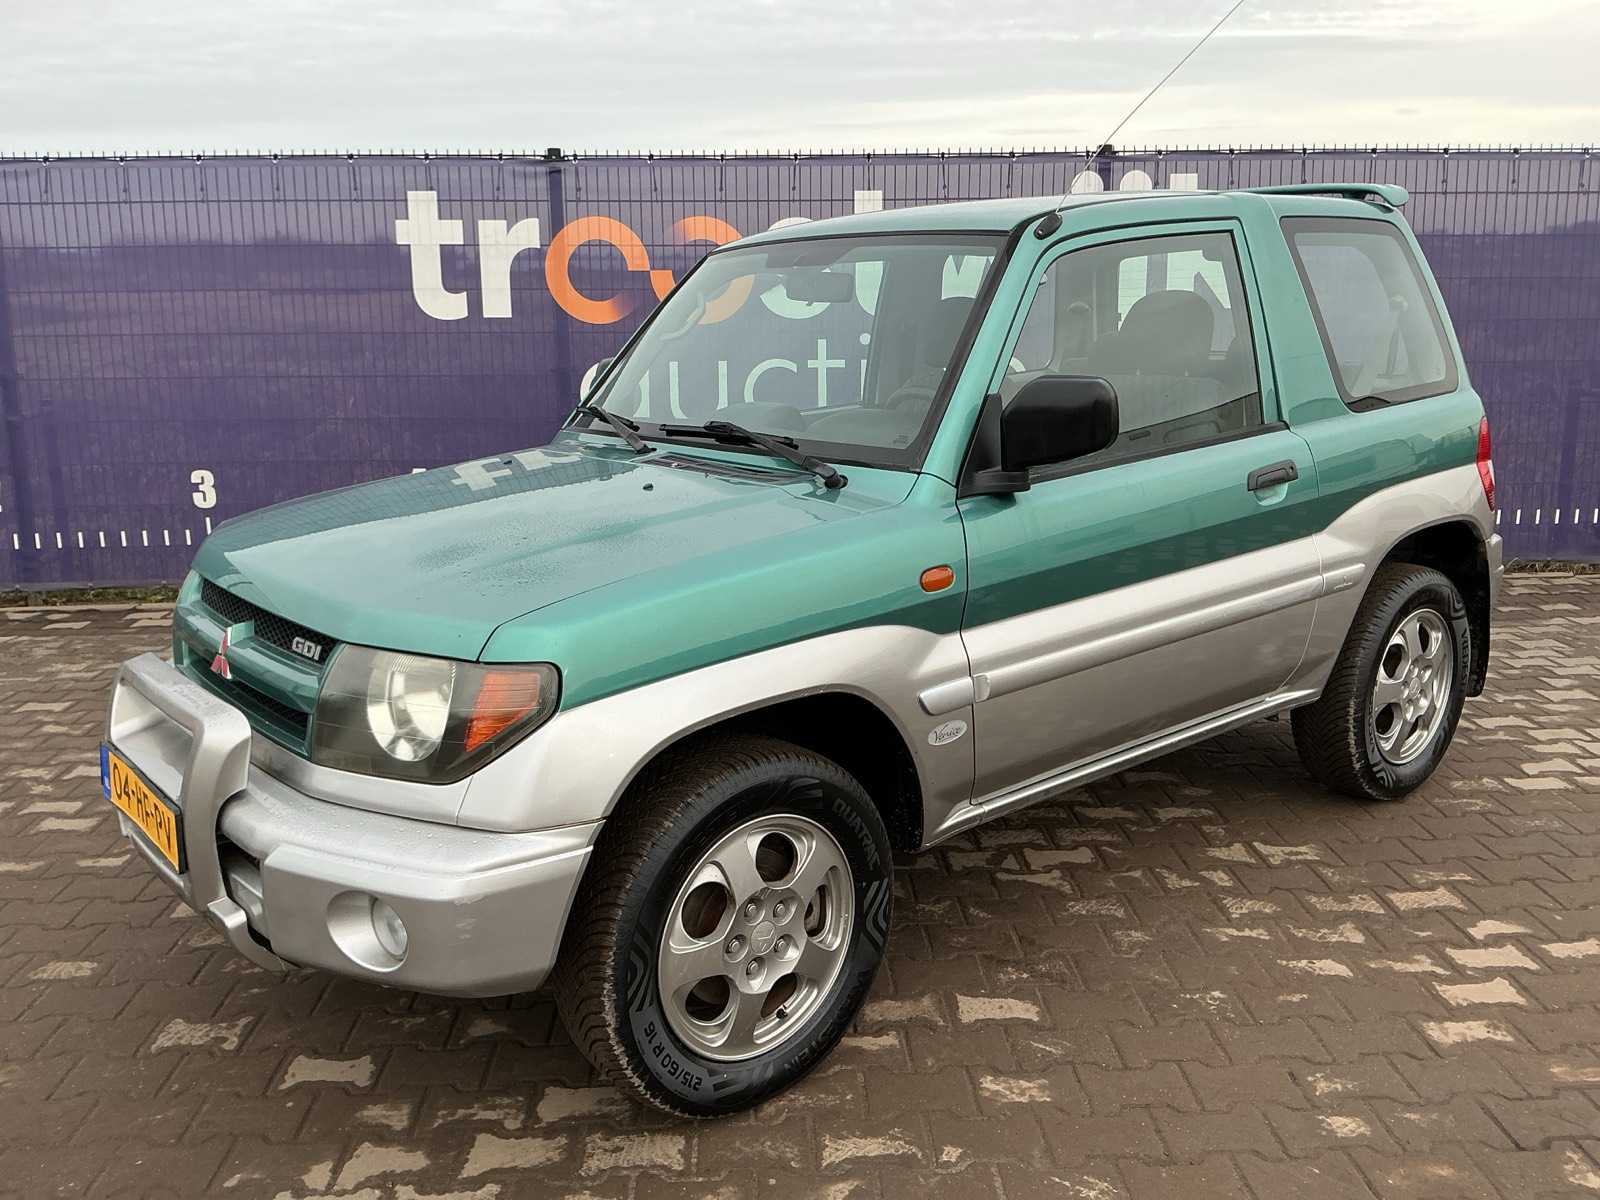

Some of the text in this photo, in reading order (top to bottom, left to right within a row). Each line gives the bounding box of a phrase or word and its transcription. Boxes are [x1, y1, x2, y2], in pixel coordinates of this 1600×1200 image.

[190, 469, 217, 509] 3
[292, 636, 322, 661] GDI
[113, 762, 171, 853] 04-HF-PV
